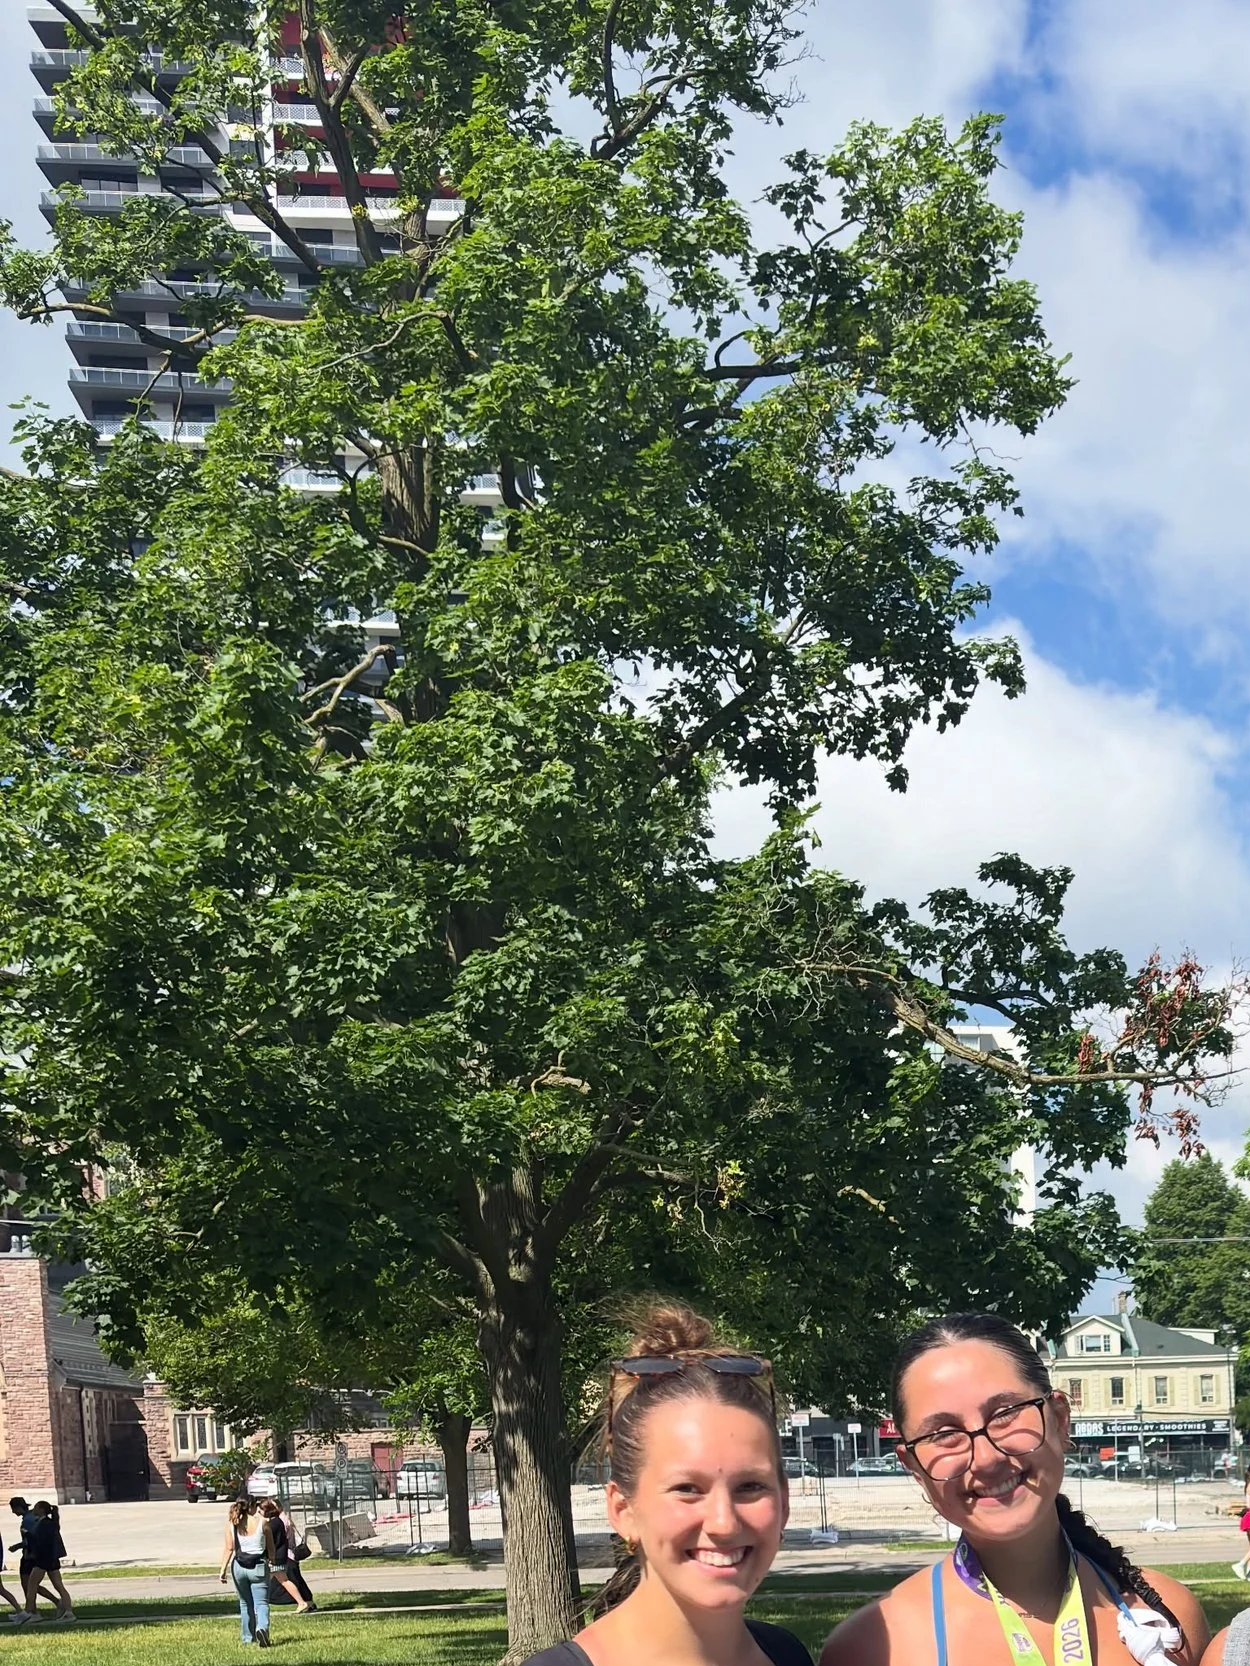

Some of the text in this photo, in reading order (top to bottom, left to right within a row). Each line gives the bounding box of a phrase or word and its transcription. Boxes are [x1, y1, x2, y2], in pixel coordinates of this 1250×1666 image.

[1106, 1424, 1154, 1432] LEGENDARY
[1159, 1423, 1207, 1431] SMOOTHIES
[1060, 1618, 1084, 1664] 2026
